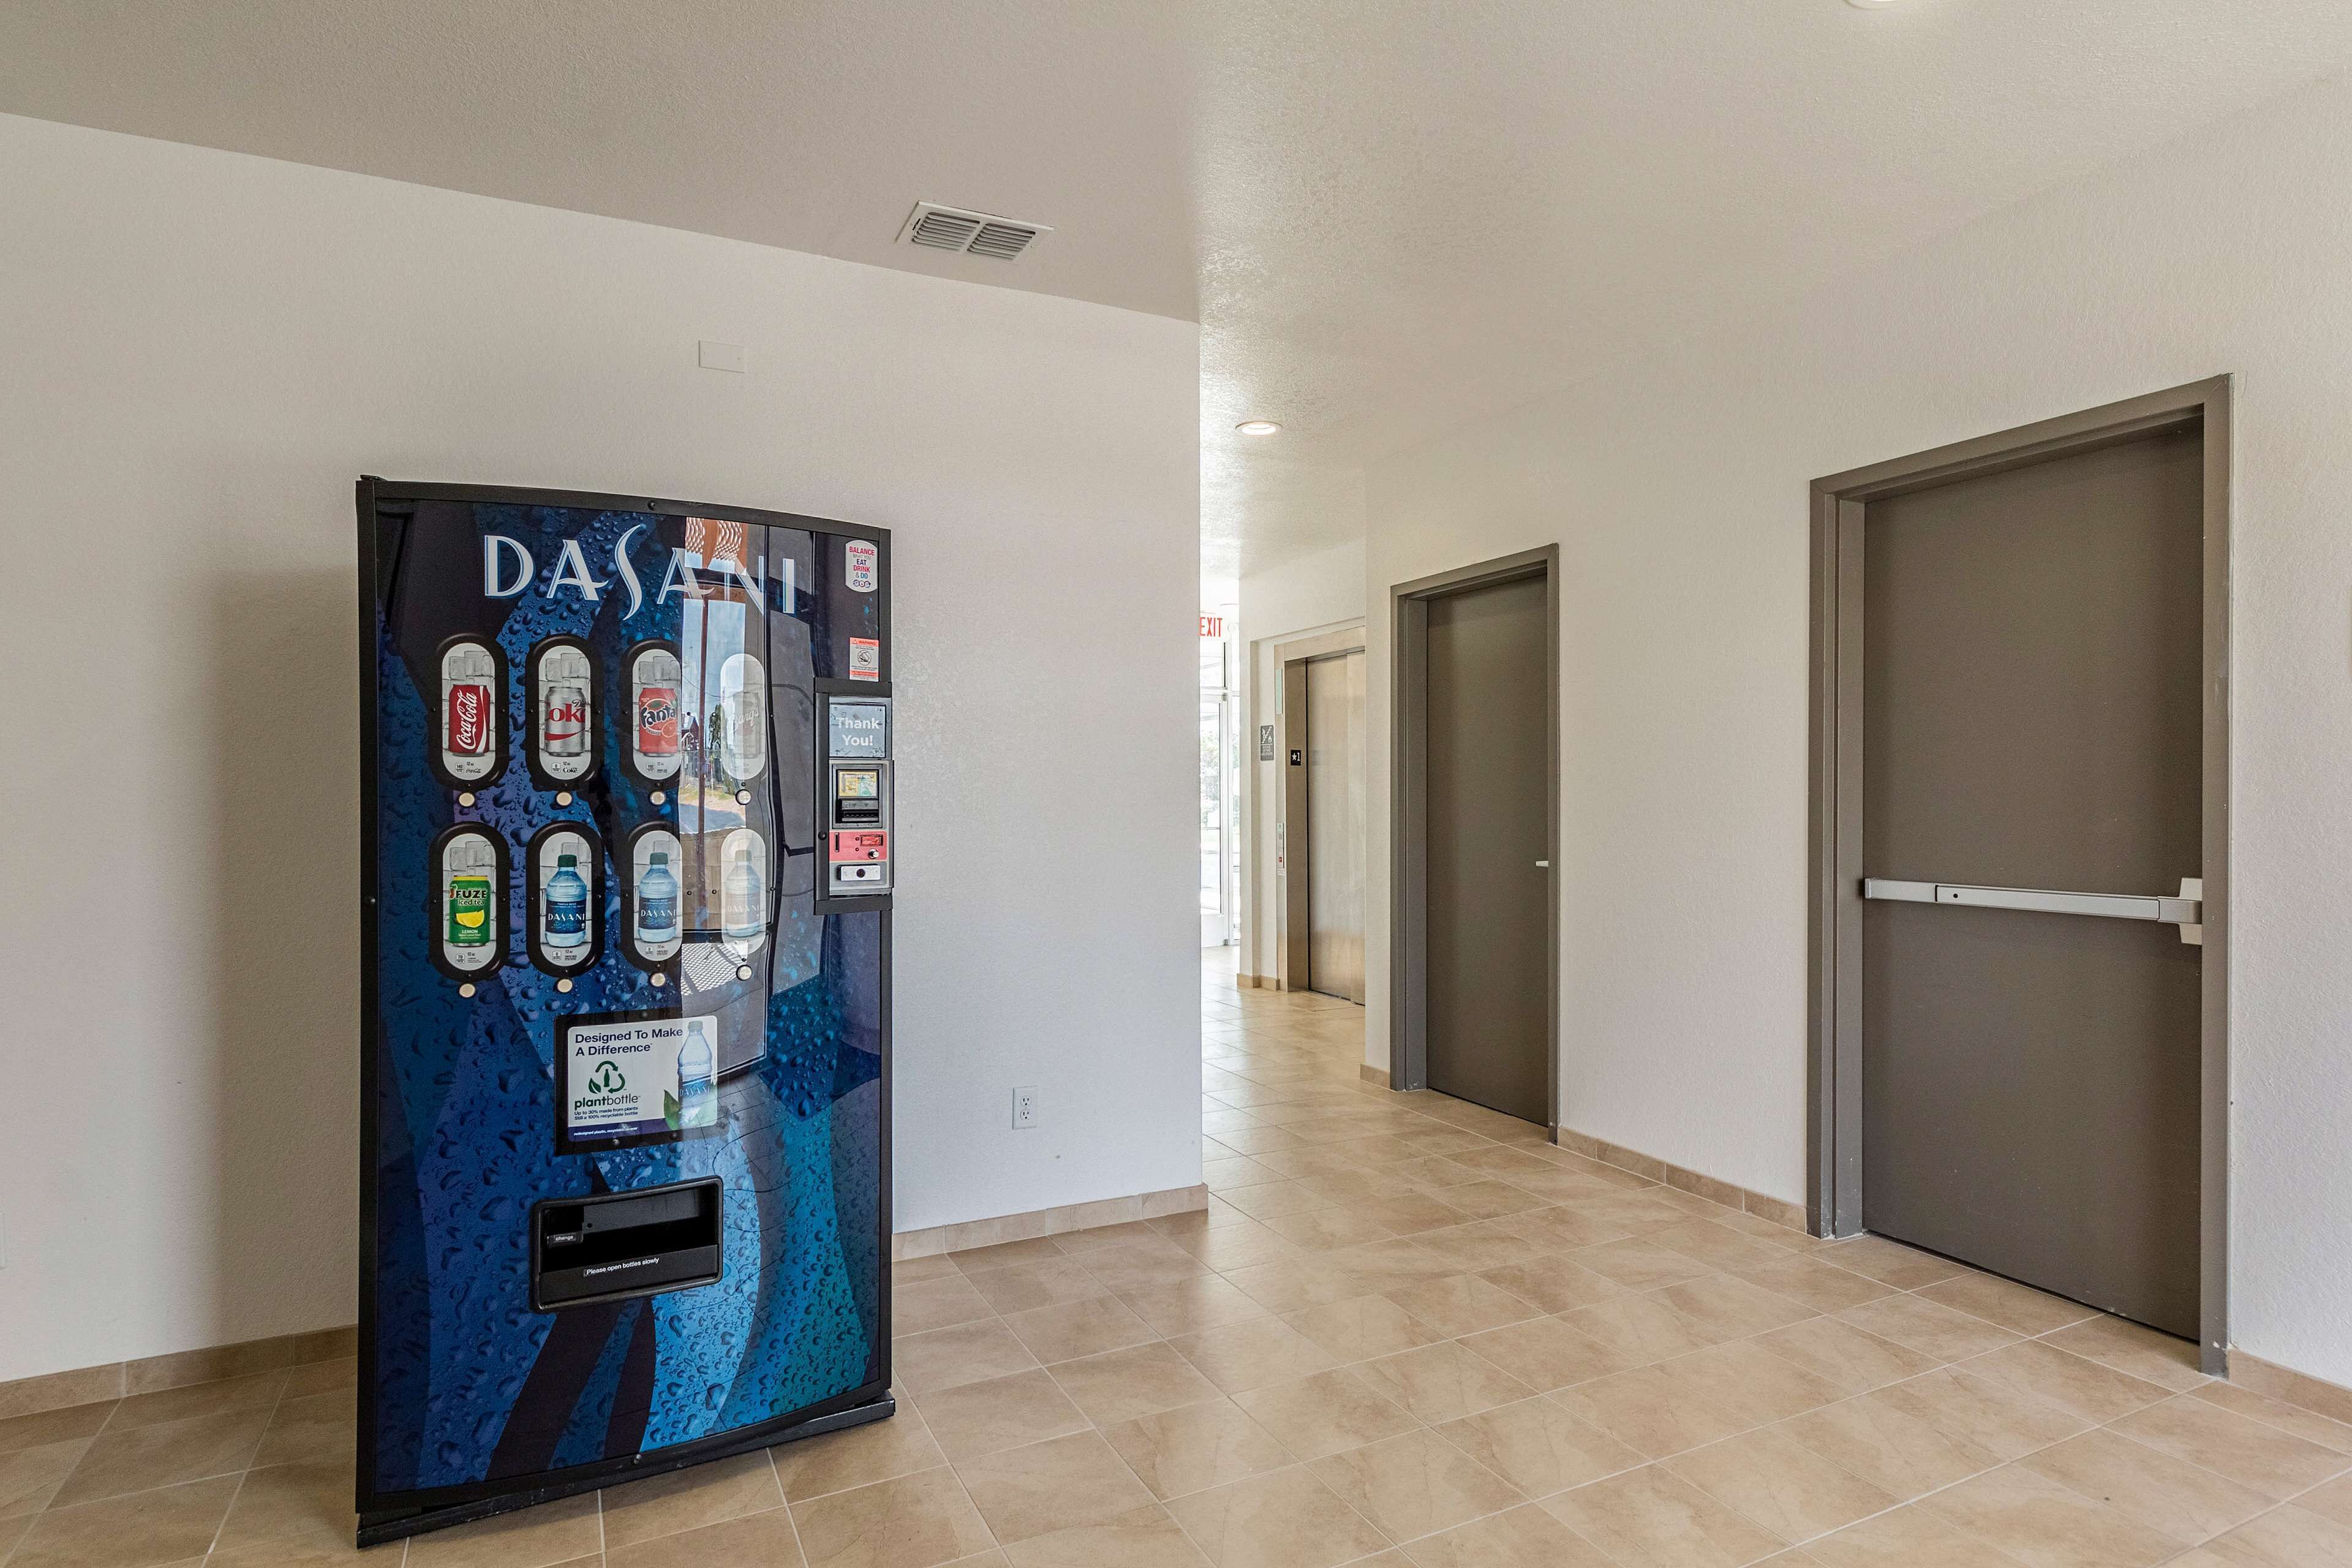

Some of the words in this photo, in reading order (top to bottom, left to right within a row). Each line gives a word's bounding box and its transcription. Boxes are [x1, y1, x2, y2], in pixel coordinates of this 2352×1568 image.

[849, 546, 875, 556] BALANCE
[484, 524, 795, 620] DASANI
[1199, 617, 1223, 637] EXIT
[641, 704, 676, 729] Fanta
[837, 717, 880, 729] Thank
[842, 735, 873, 746] You!
[456, 890, 487, 899] FUZE
[548, 913, 585, 921] DASANI
[641, 909, 676, 918] DASANI
[575, 1031, 631, 1044] Designed
[635, 1030, 648, 1039] To
[652, 1028, 683, 1038] Make
[575, 1047, 585, 1057] A
[680, 1086, 710, 1096] DASANI
